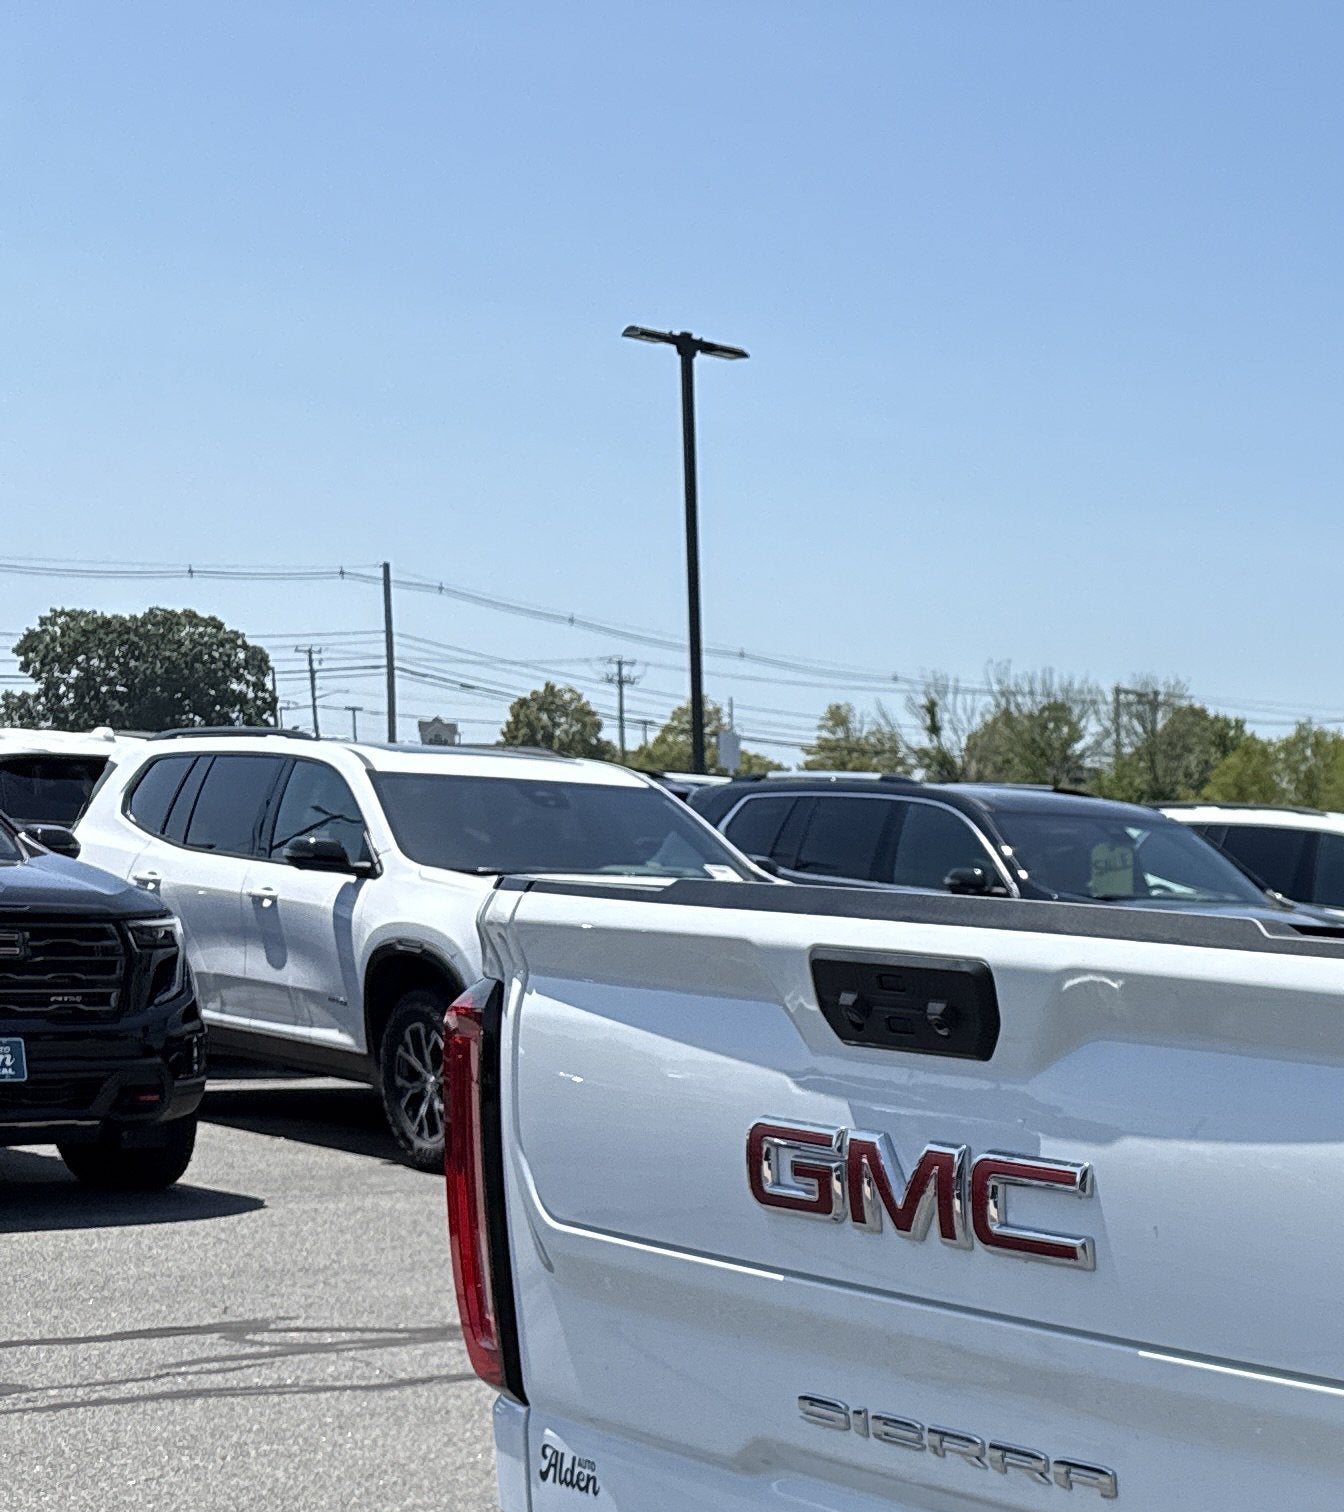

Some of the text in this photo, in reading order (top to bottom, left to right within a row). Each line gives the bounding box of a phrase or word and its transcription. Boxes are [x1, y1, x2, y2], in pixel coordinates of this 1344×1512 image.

[746, 1114, 1097, 1272] GMC
[539, 1443, 600, 1497] Alden
[797, 1391, 1119, 1499] SIERRA
